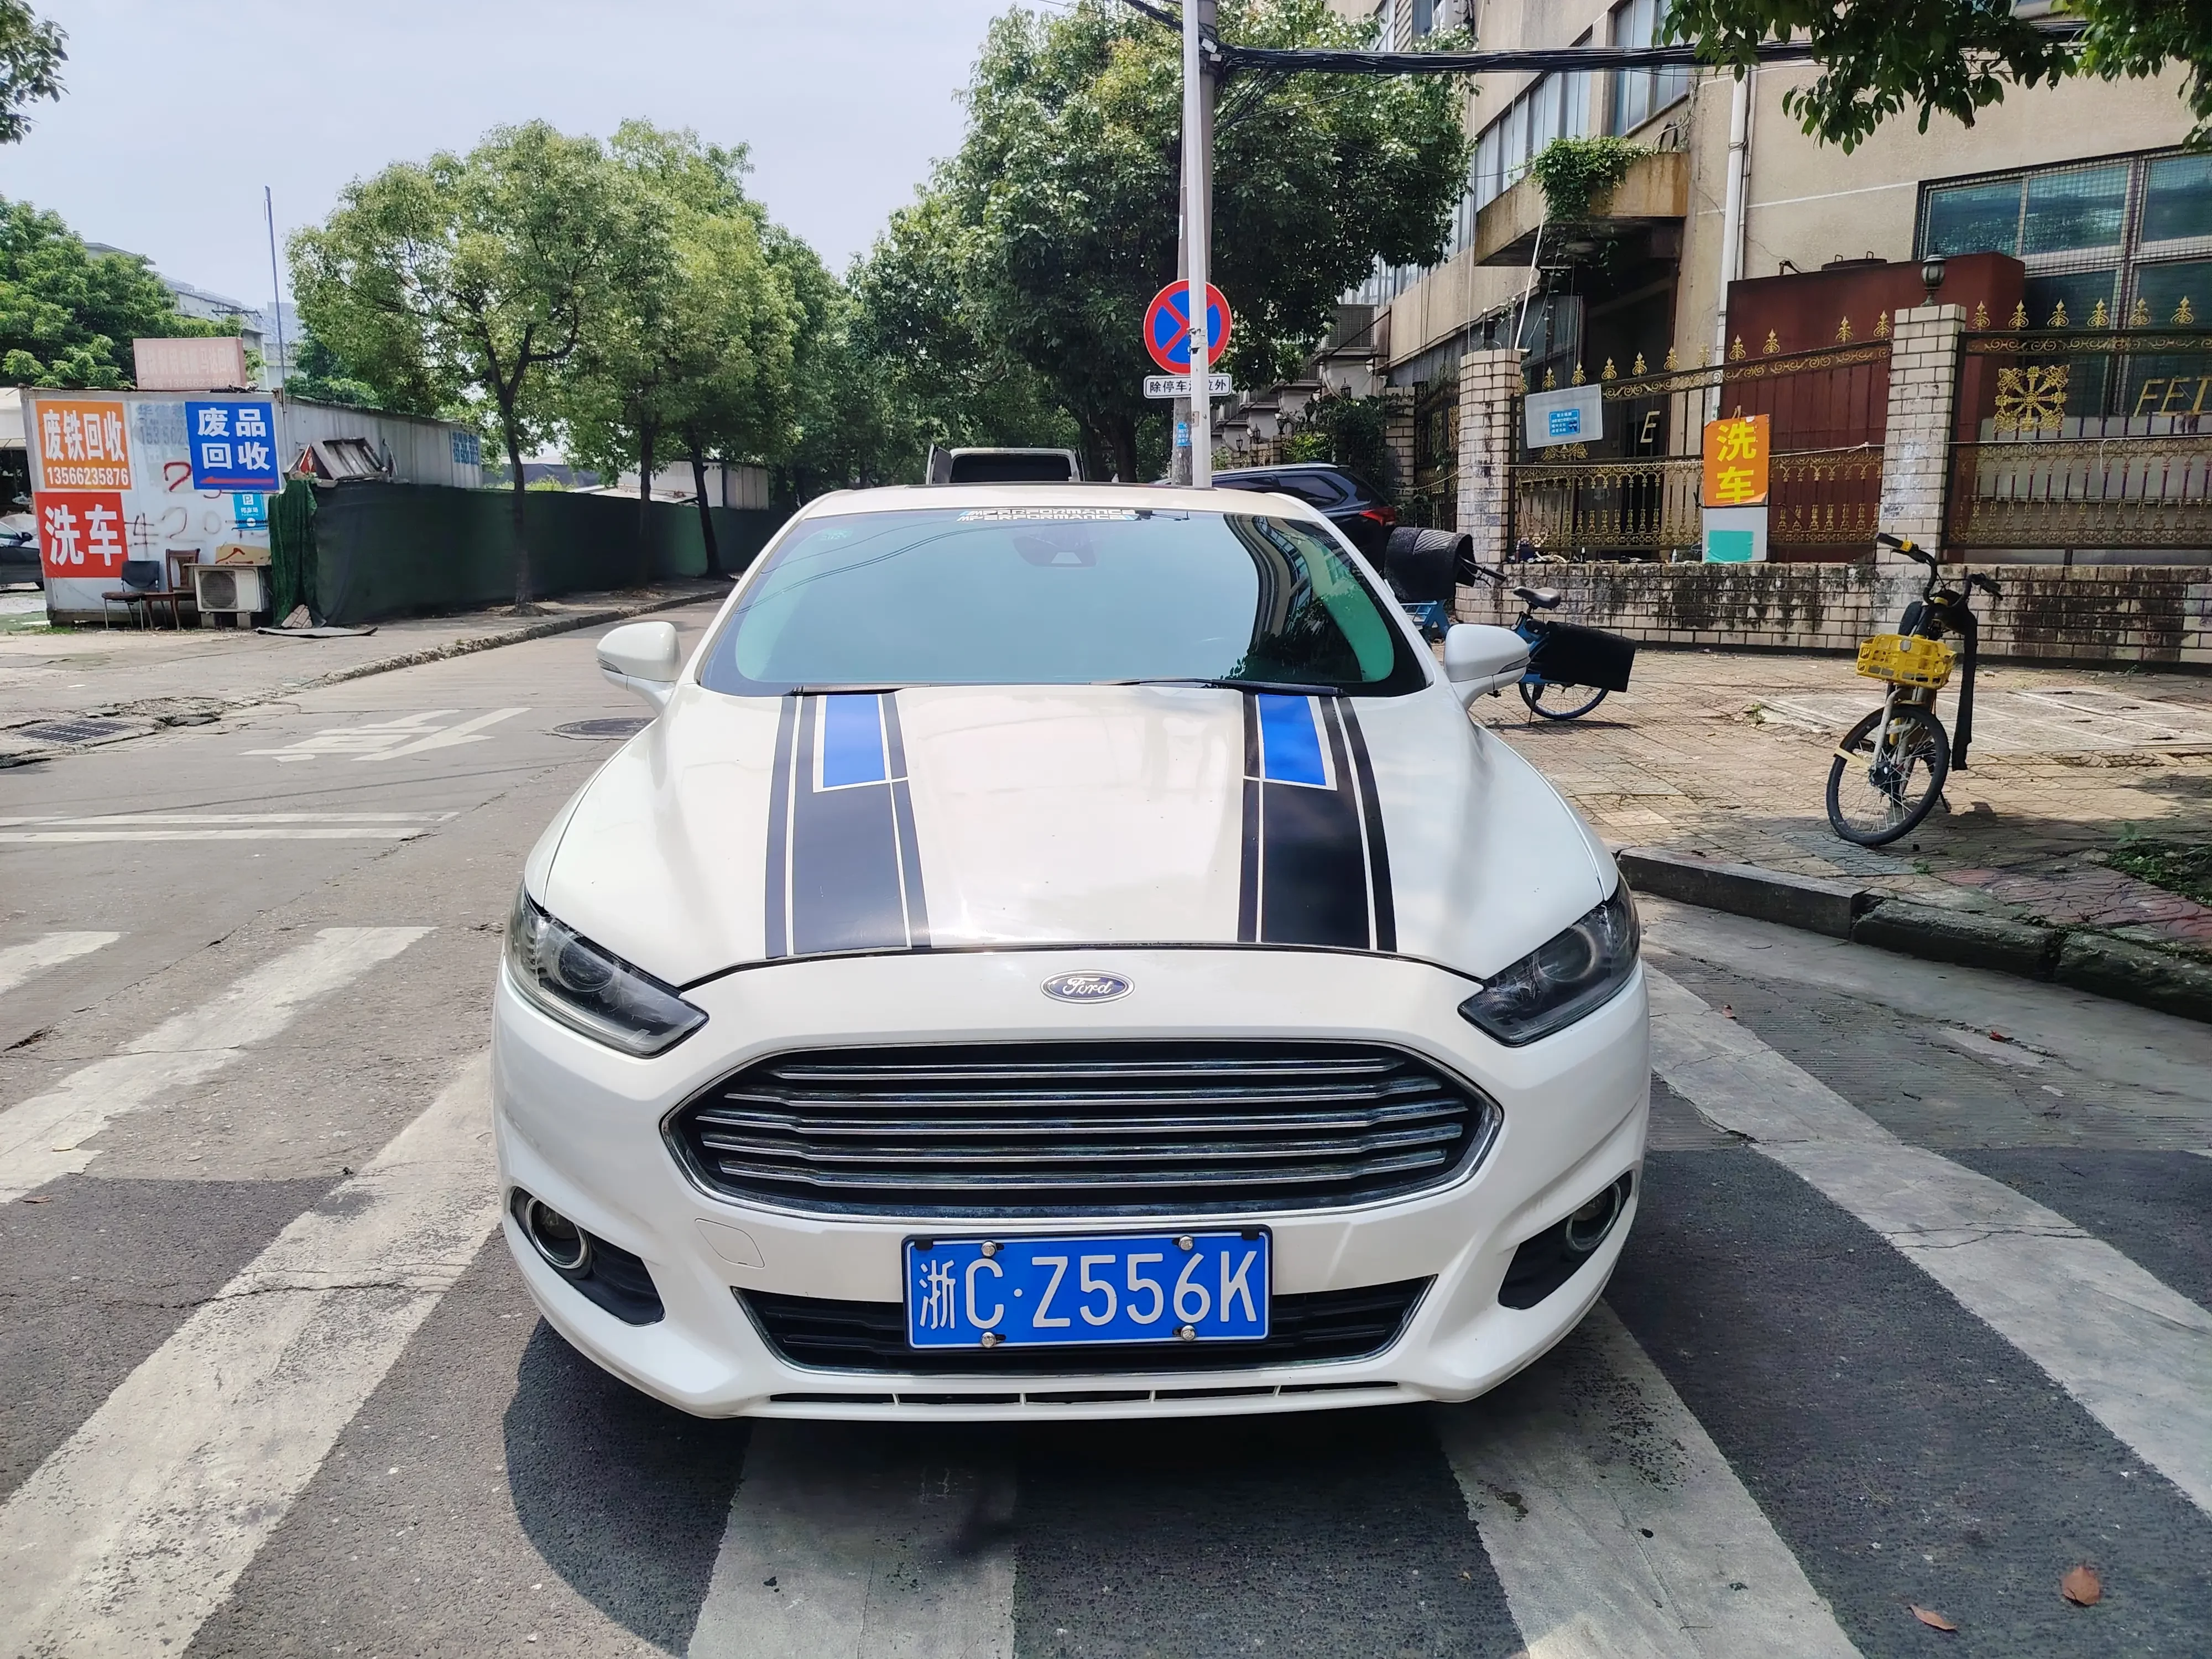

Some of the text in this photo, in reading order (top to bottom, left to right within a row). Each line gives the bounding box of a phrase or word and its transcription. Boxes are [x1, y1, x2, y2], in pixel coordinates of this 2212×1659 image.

[1150, 379, 1227, 393] 除停车外
[43, 409, 125, 462] 废铁回收
[197, 408, 267, 437] 废品
[201, 441, 271, 470] 回收
[1716, 421, 1757, 504] 洗车
[47, 467, 129, 486] 13566235876
[44, 504, 122, 566] 洗车
[1062, 977, 1114, 996] Ford
